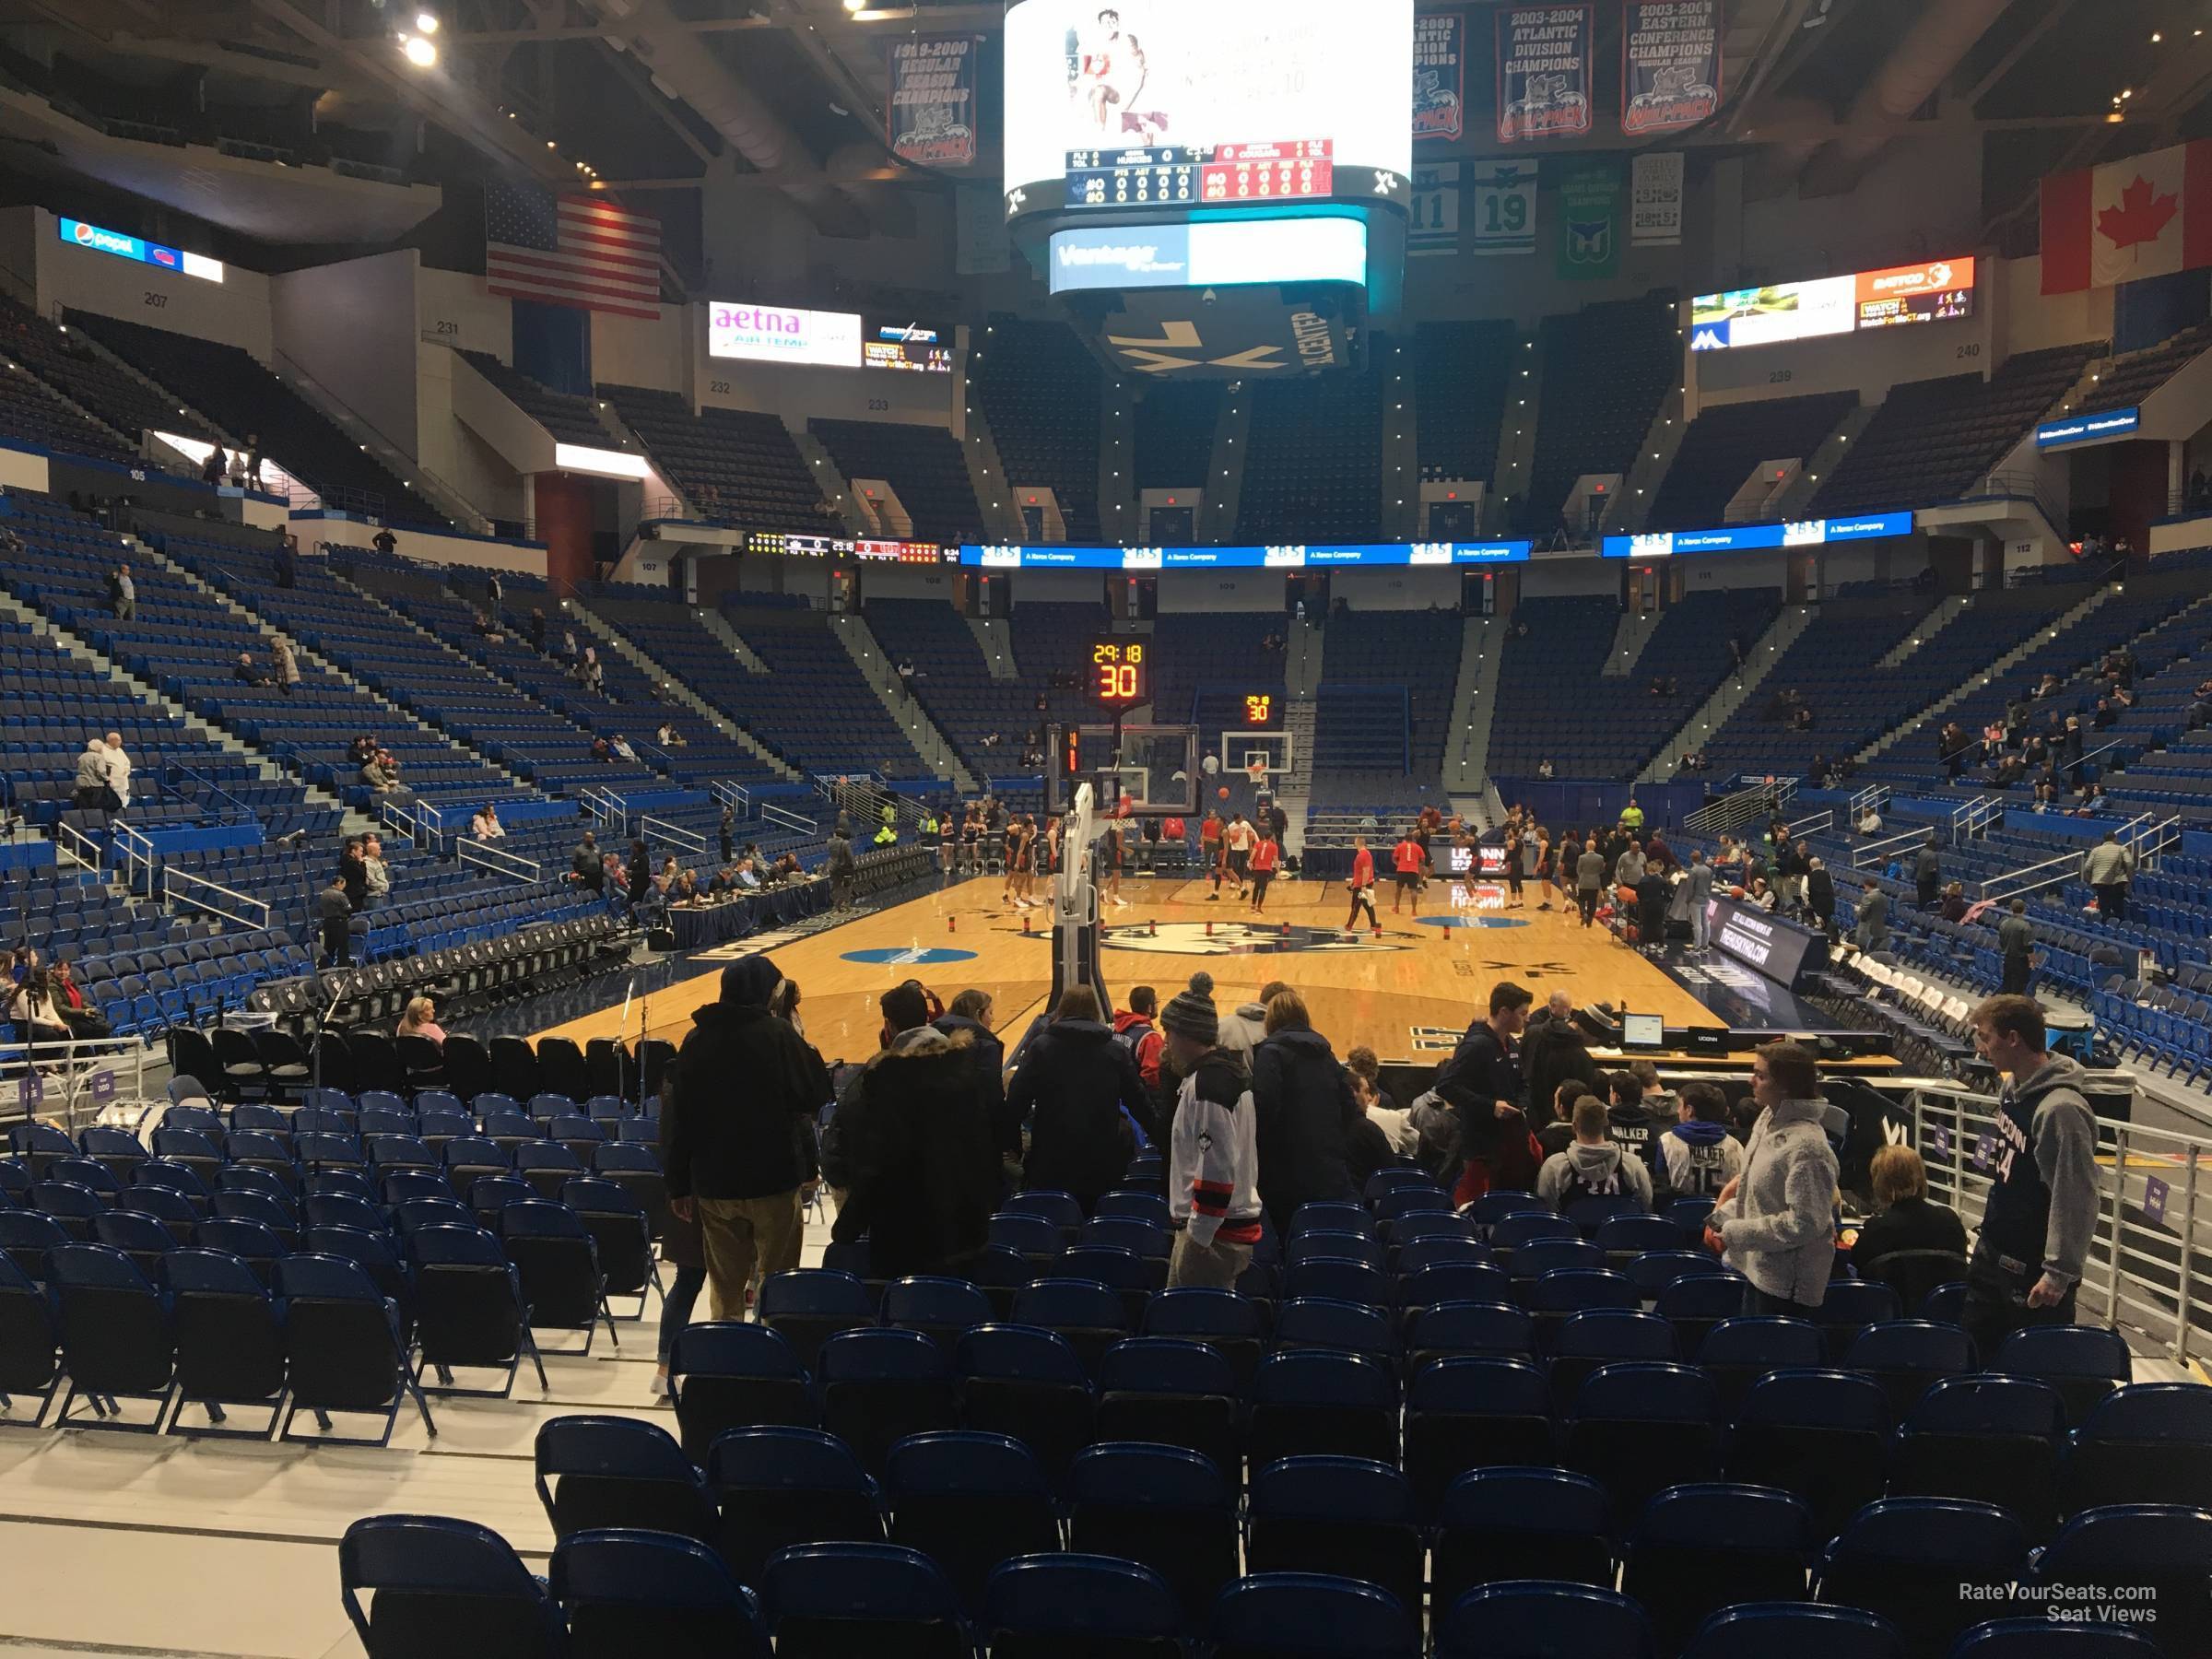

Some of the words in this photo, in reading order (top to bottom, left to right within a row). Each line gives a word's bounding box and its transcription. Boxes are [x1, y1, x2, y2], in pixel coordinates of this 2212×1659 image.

[1512, 9, 1583, 26] 2003-2004
[1641, 15, 1708, 29] EASTERN
[1513, 26, 1578, 41] ATLANTIC
[1630, 29, 1715, 45] CONFERENCE
[1514, 41, 1573, 57] DIVISION
[1630, 43, 1713, 59] CHAMPIONS
[900, 58, 961, 73] REGULAR
[1505, 57, 1581, 74] CHAMPIONS
[904, 74, 958, 88] SEASON
[892, 88, 971, 105] CHAMPIONS
[1117, 156, 1152, 164] HUSKIES
[1162, 149, 1172, 162] 0
[1223, 147, 1234, 159] 0
[1373, 171, 1397, 194] XL
[1008, 189, 1027, 214] XL
[1485, 194, 1527, 231] 19
[144, 292, 168, 308] 207
[437, 321, 458, 335] 231
[715, 307, 801, 335] aetna
[734, 333, 762, 346] AIR
[1291, 312, 1333, 355] CENTER
[1957, 344, 1980, 359] 240
[1770, 371, 1792, 383] 239
[710, 381, 730, 394] 232
[868, 399, 888, 411] 233
[130, 469, 146, 482] 105
[1854, 522, 1884, 532] Company
[814, 540, 821, 548] 0
[1701, 535, 1732, 545] Company
[864, 544, 871, 553] 0
[1333, 550, 1361, 559] Company
[1480, 547, 1510, 557] Company
[2016, 544, 2030, 553] 112
[1048, 553, 1076, 561] Company
[1189, 553, 1217, 561] Company
[1094, 644, 1142, 663] 29:18
[1100, 665, 1137, 698] 30
[1250, 705, 1268, 721] 30
[1452, 848, 1505, 860] UCNN
[1612, 1126, 1649, 1141] WALKER
